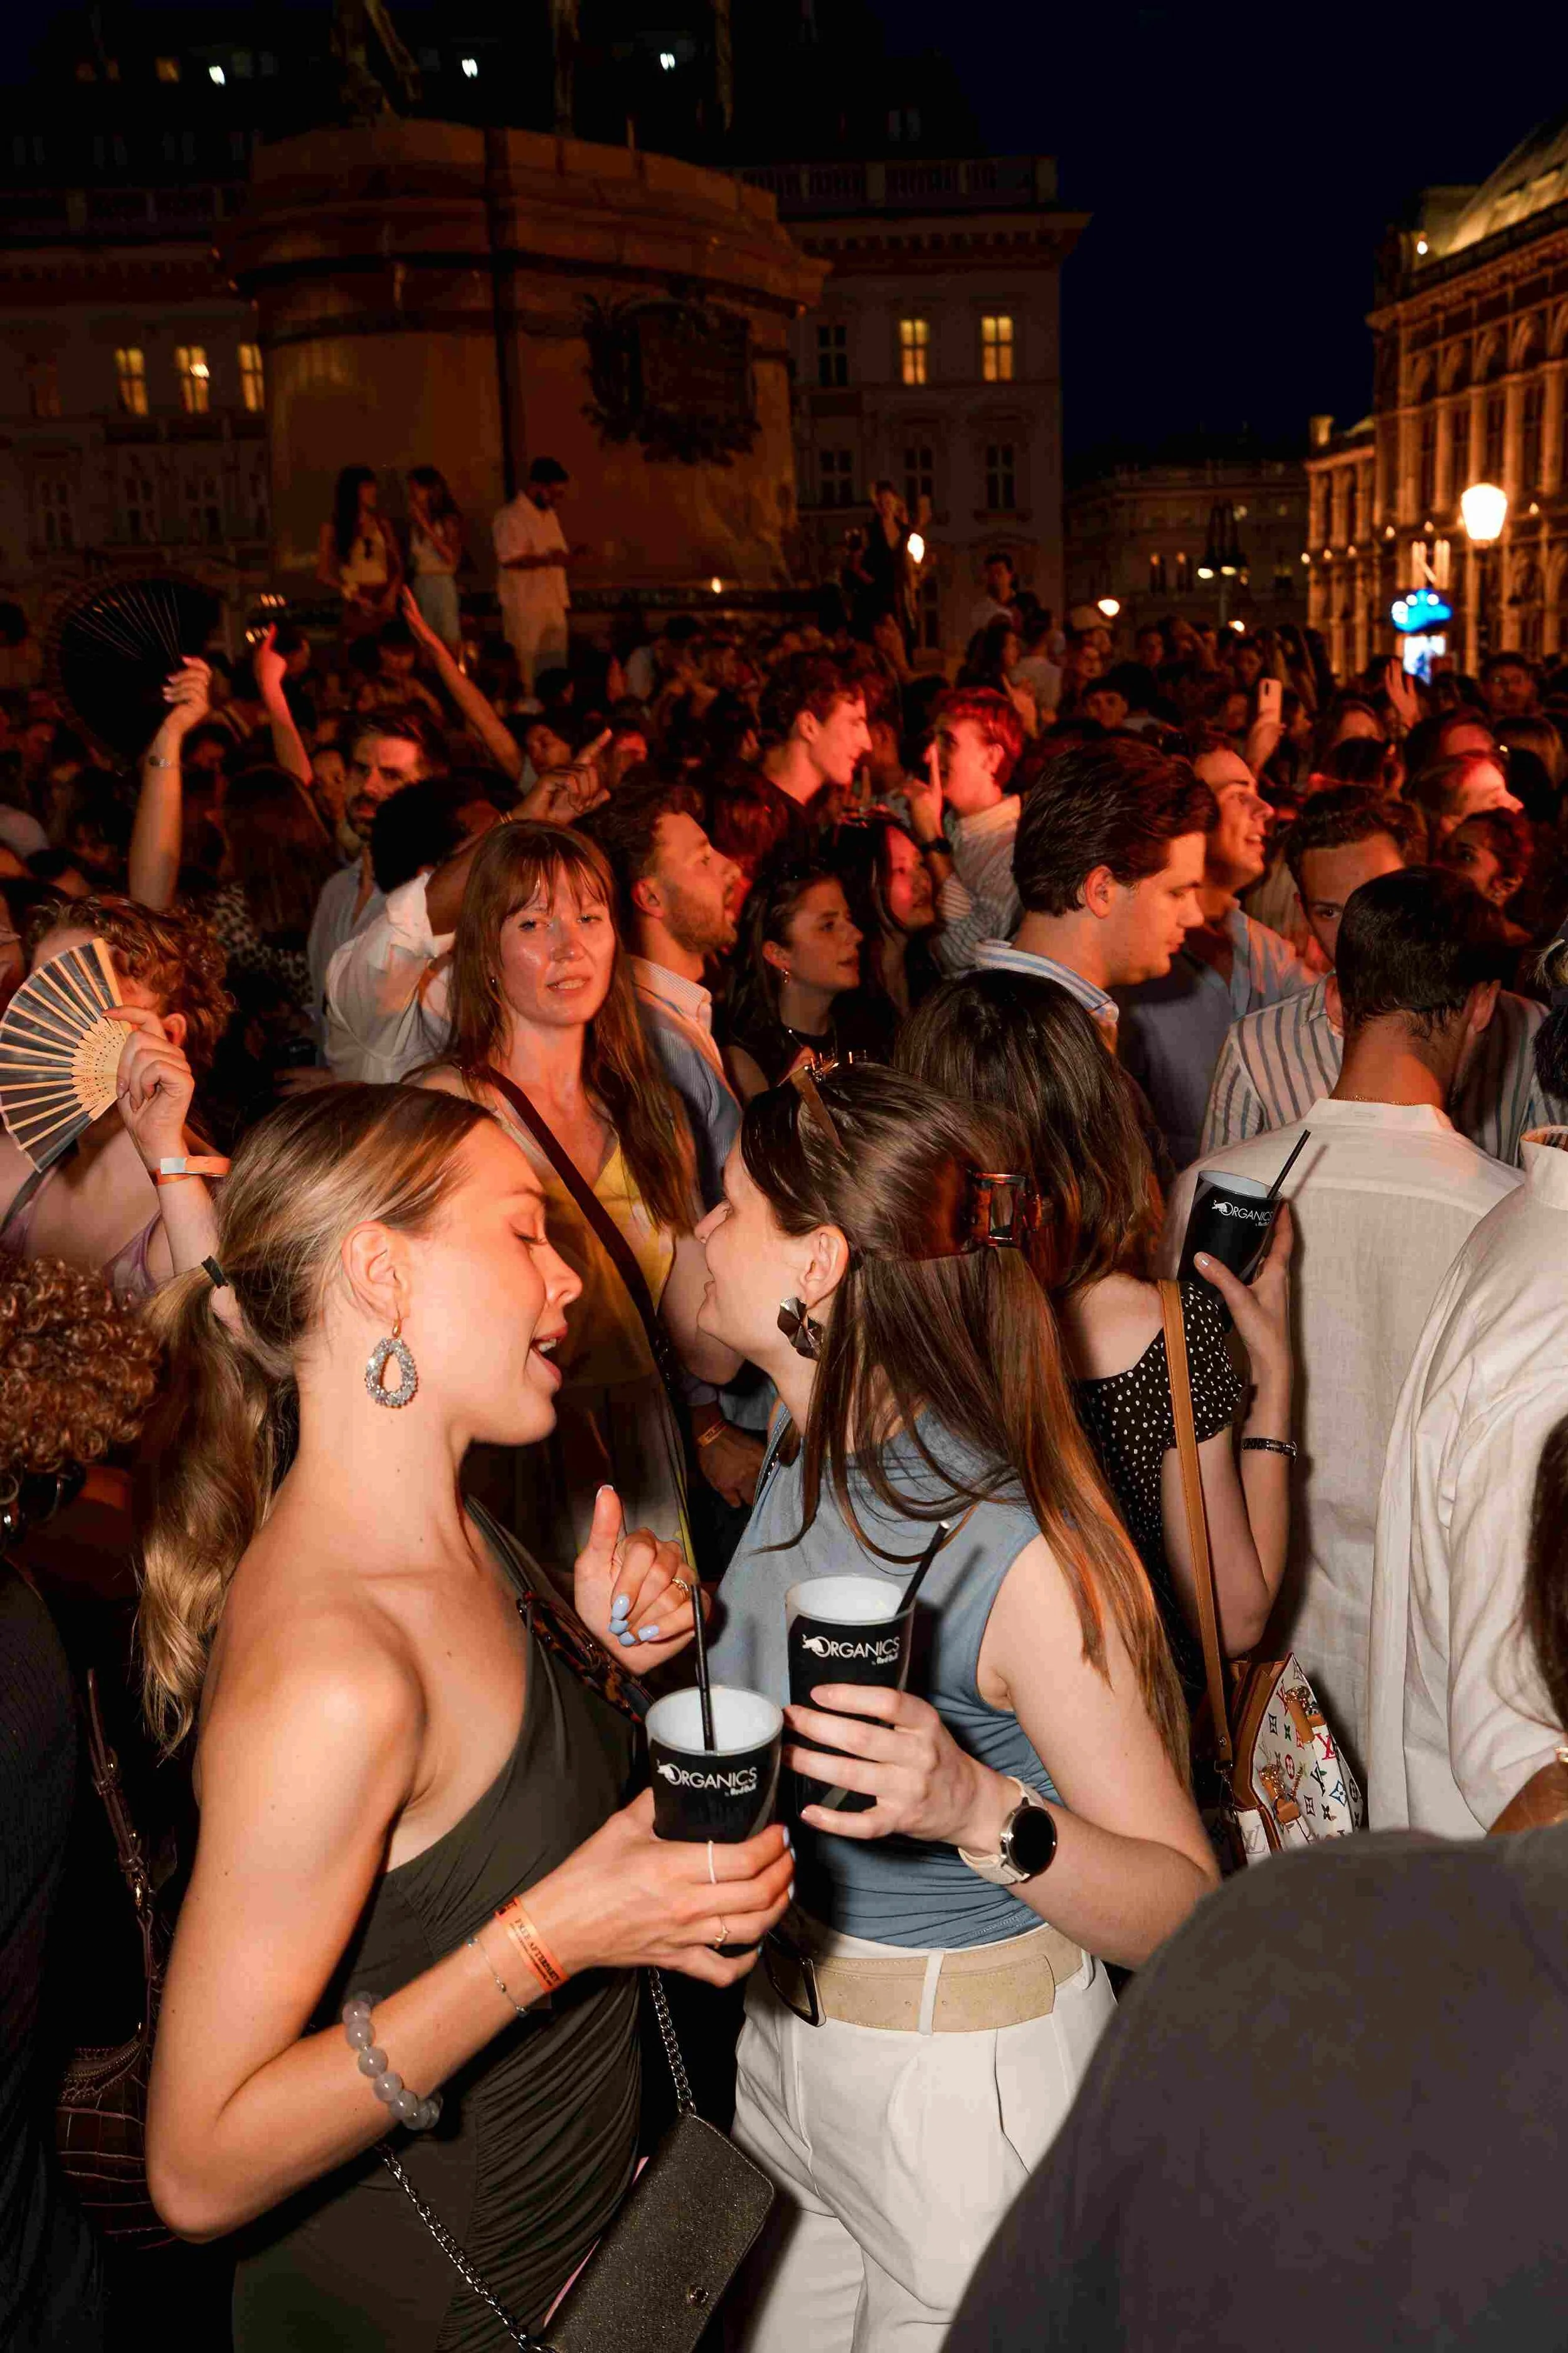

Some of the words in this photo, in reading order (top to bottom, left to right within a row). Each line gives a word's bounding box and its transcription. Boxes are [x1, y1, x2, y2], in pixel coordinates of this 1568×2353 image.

[1219, 1202, 1273, 1221] ORGANICS
[812, 1636, 900, 1658] ORGANICS
[664, 1763, 758, 1789] ORGANICS
